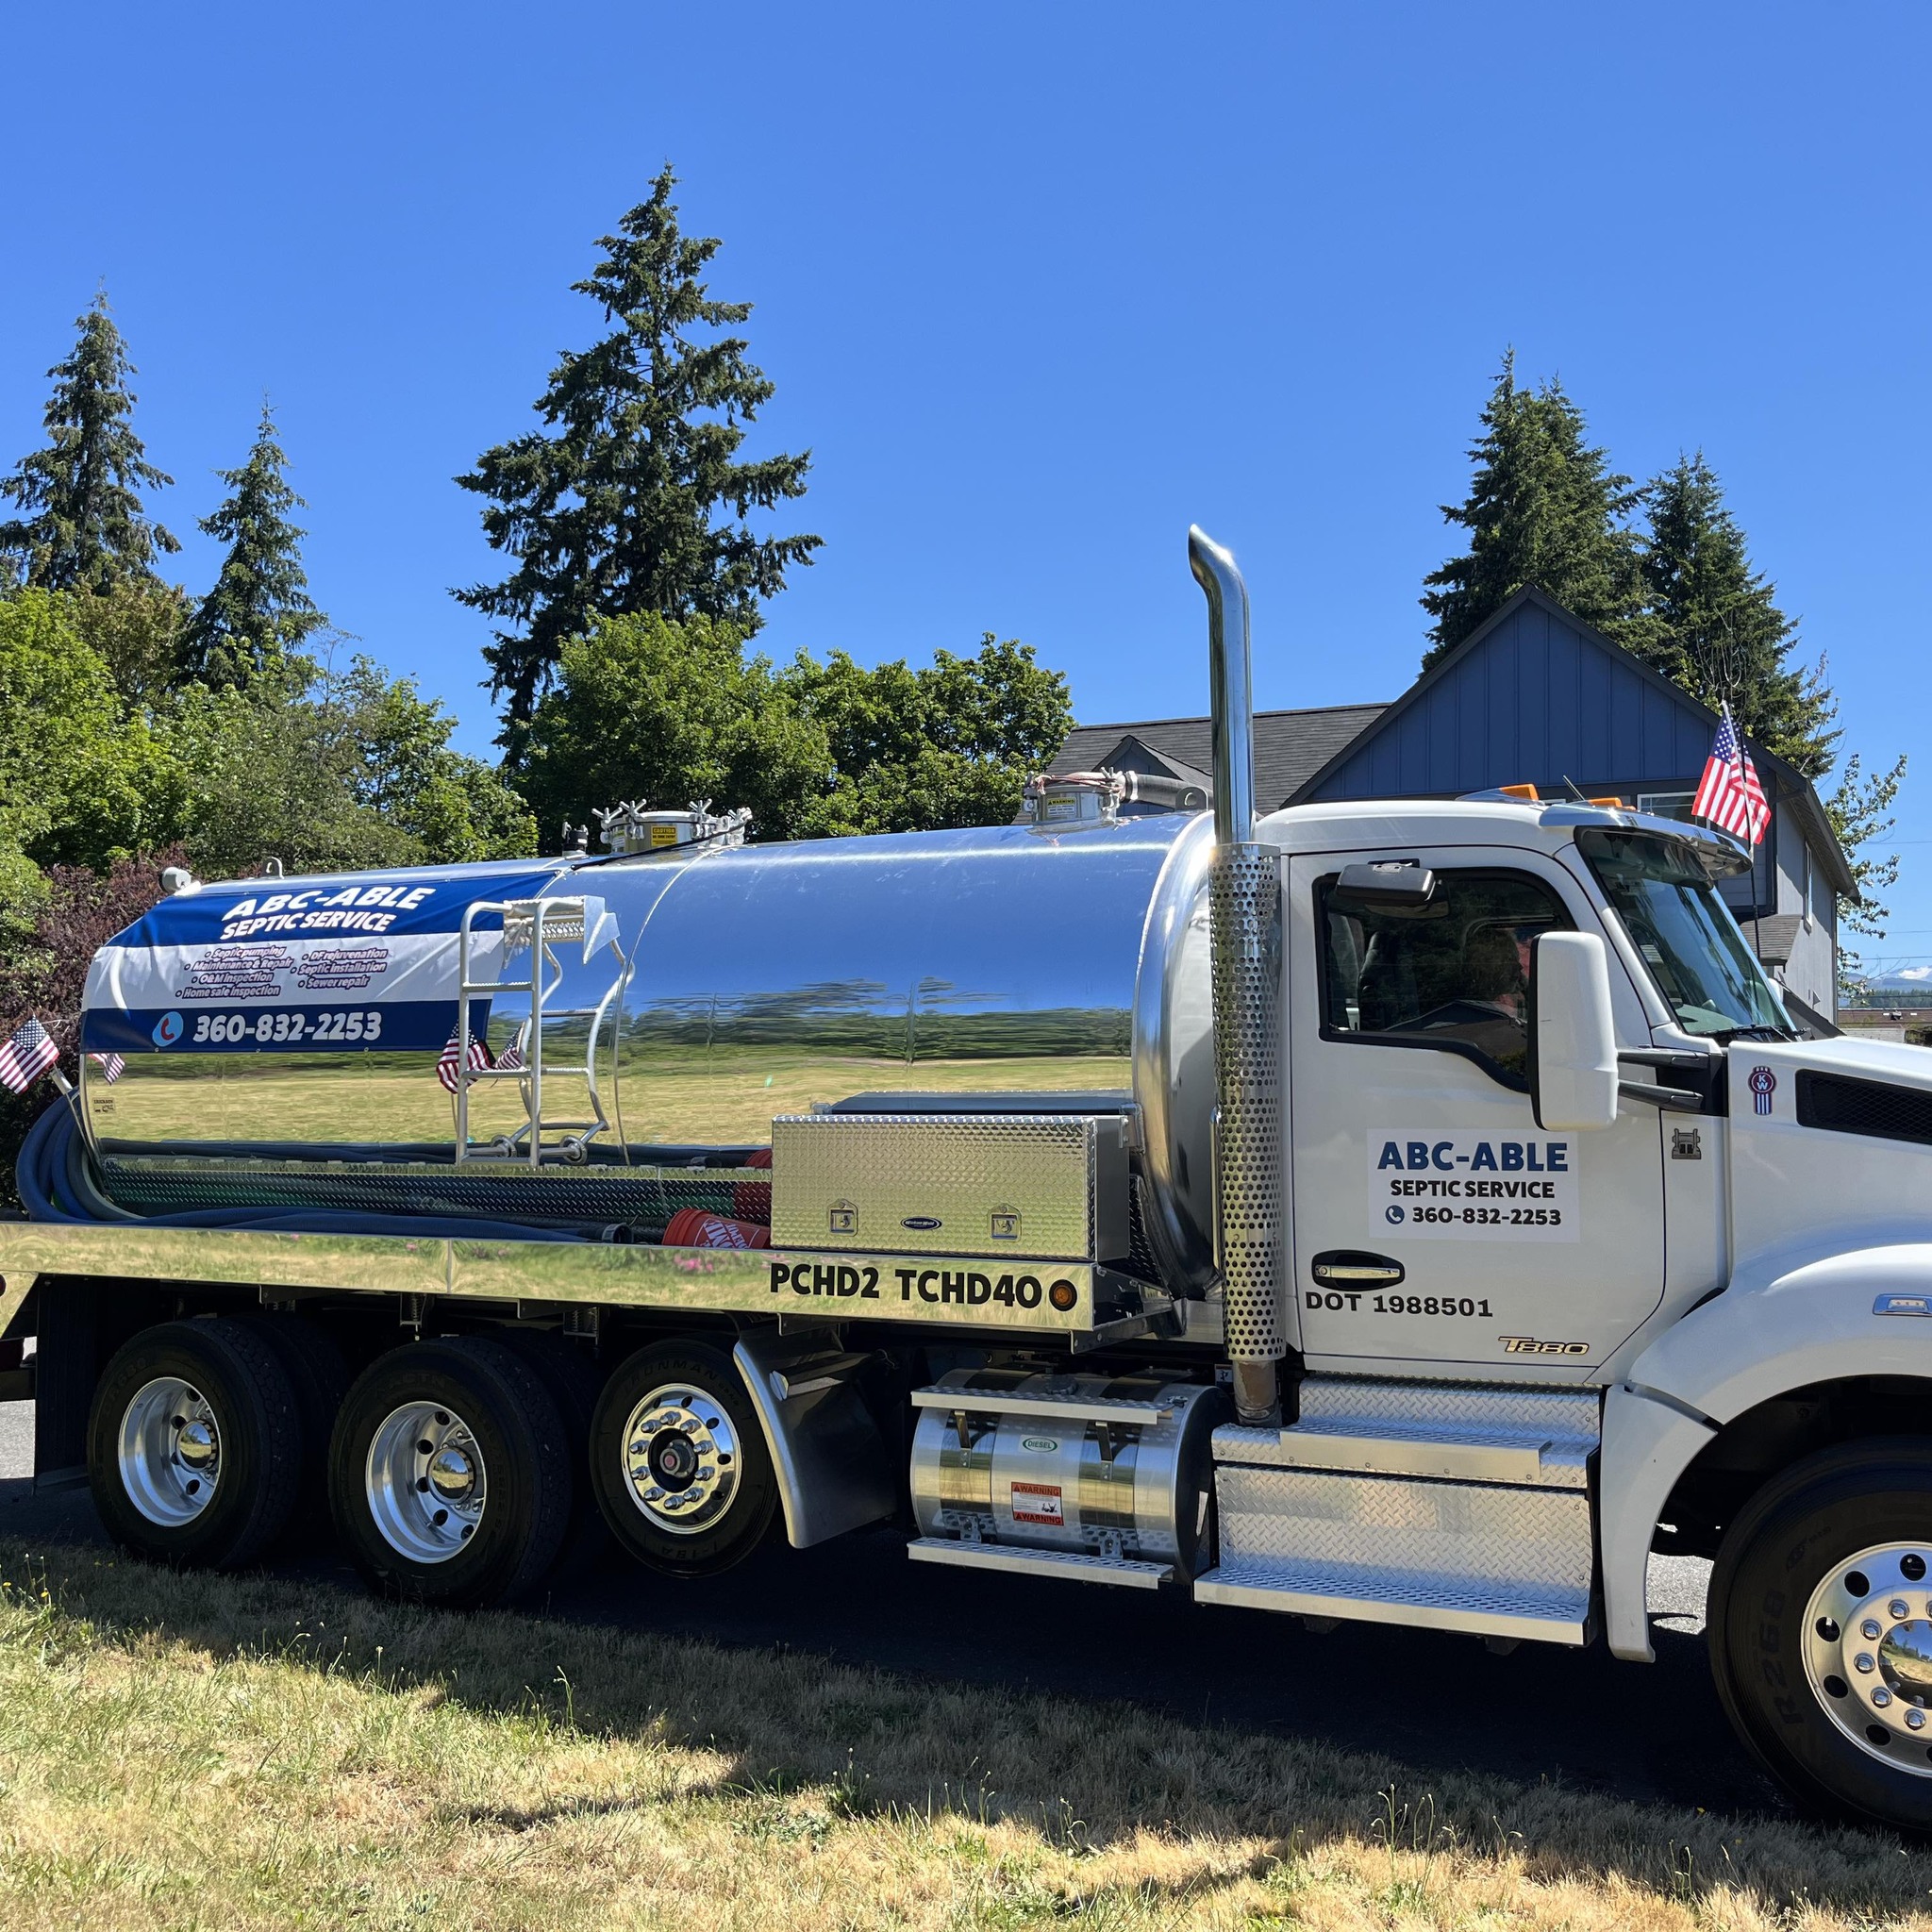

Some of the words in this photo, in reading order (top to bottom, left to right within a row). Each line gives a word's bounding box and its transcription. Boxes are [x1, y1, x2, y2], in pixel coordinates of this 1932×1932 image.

[221, 886, 437, 922] ABC-ABLE
[219, 912, 304, 940] SEPTIC
[302, 911, 397, 932] SERVICE
[211, 946, 242, 959] Septic
[240, 945, 287, 960] pumping
[323, 947, 389, 962] rejuvenation
[191, 960, 252, 972] Maintenance
[252, 958, 260, 969] &
[259, 957, 294, 971] Repair
[297, 962, 330, 976] Septic
[329, 960, 388, 974] installation
[224, 971, 275, 986] inspection
[306, 976, 338, 989] Sewer
[337, 974, 371, 990] repair
[182, 987, 210, 999] Home
[229, 984, 281, 999] inspection
[192, 1011, 382, 1043] 360-832-2253
[1376, 1141, 1569, 1173] ABC-ABLE
[1390, 1179, 1461, 1197] SEPTIC
[1464, 1180, 1556, 1199] SERVICE
[1411, 1206, 1562, 1225] 360-832-2253
[769, 1262, 880, 1299] PCHD2
[894, 1269, 1042, 1309] TCHD40
[1305, 1291, 1362, 1312] DOT
[1373, 1294, 1493, 1318] 1988501
[1498, 1335, 1590, 1356] T880
[1027, 1440, 1052, 1449] DIESEL
[1020, 1485, 1059, 1496] WARNING
[1023, 1513, 1061, 1524] WARNING
